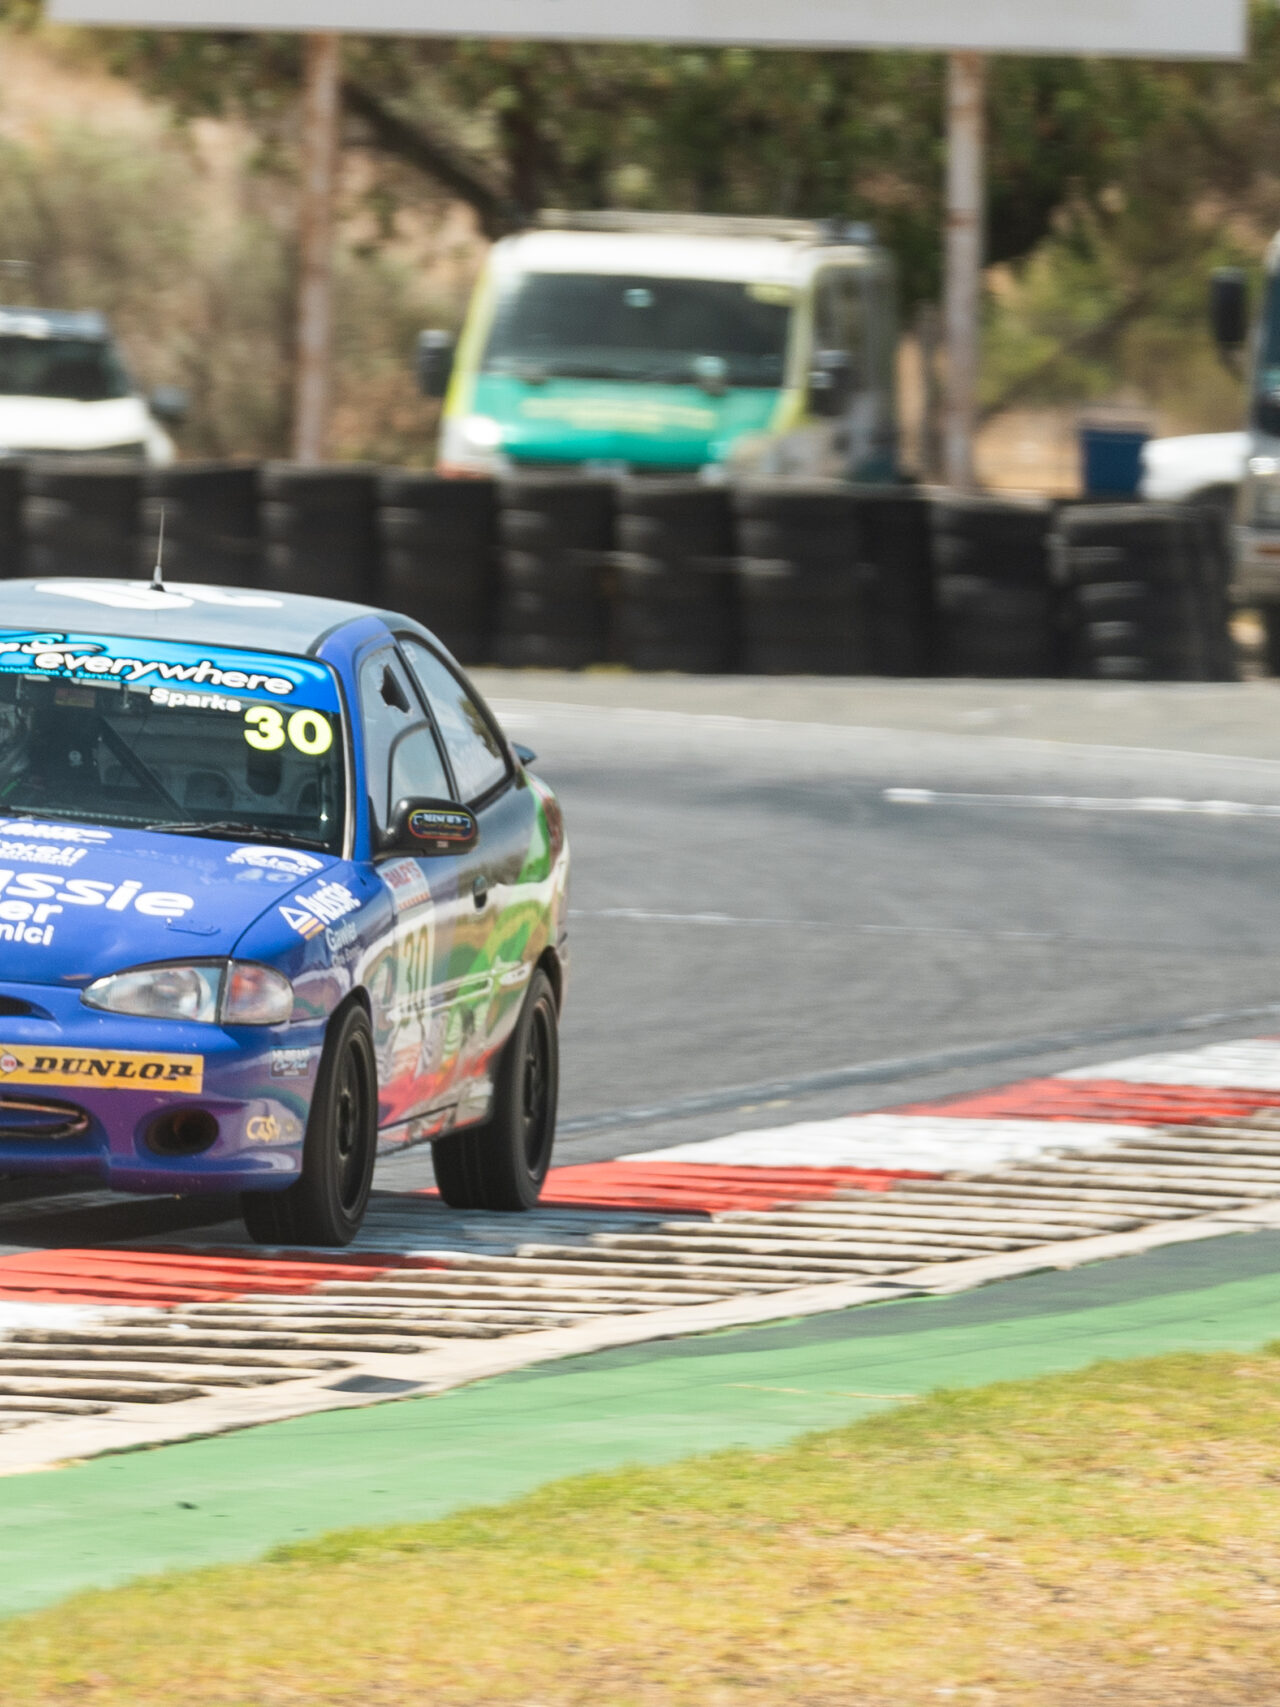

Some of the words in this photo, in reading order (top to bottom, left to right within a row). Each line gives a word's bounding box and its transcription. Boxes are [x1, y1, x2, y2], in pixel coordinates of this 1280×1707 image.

[34, 653, 294, 695] everywhere
[76, 670, 122, 681] Service
[150, 686, 242, 713] Sparks
[243, 705, 333, 756] 30
[28, 1056, 194, 1081] DUNLOP
